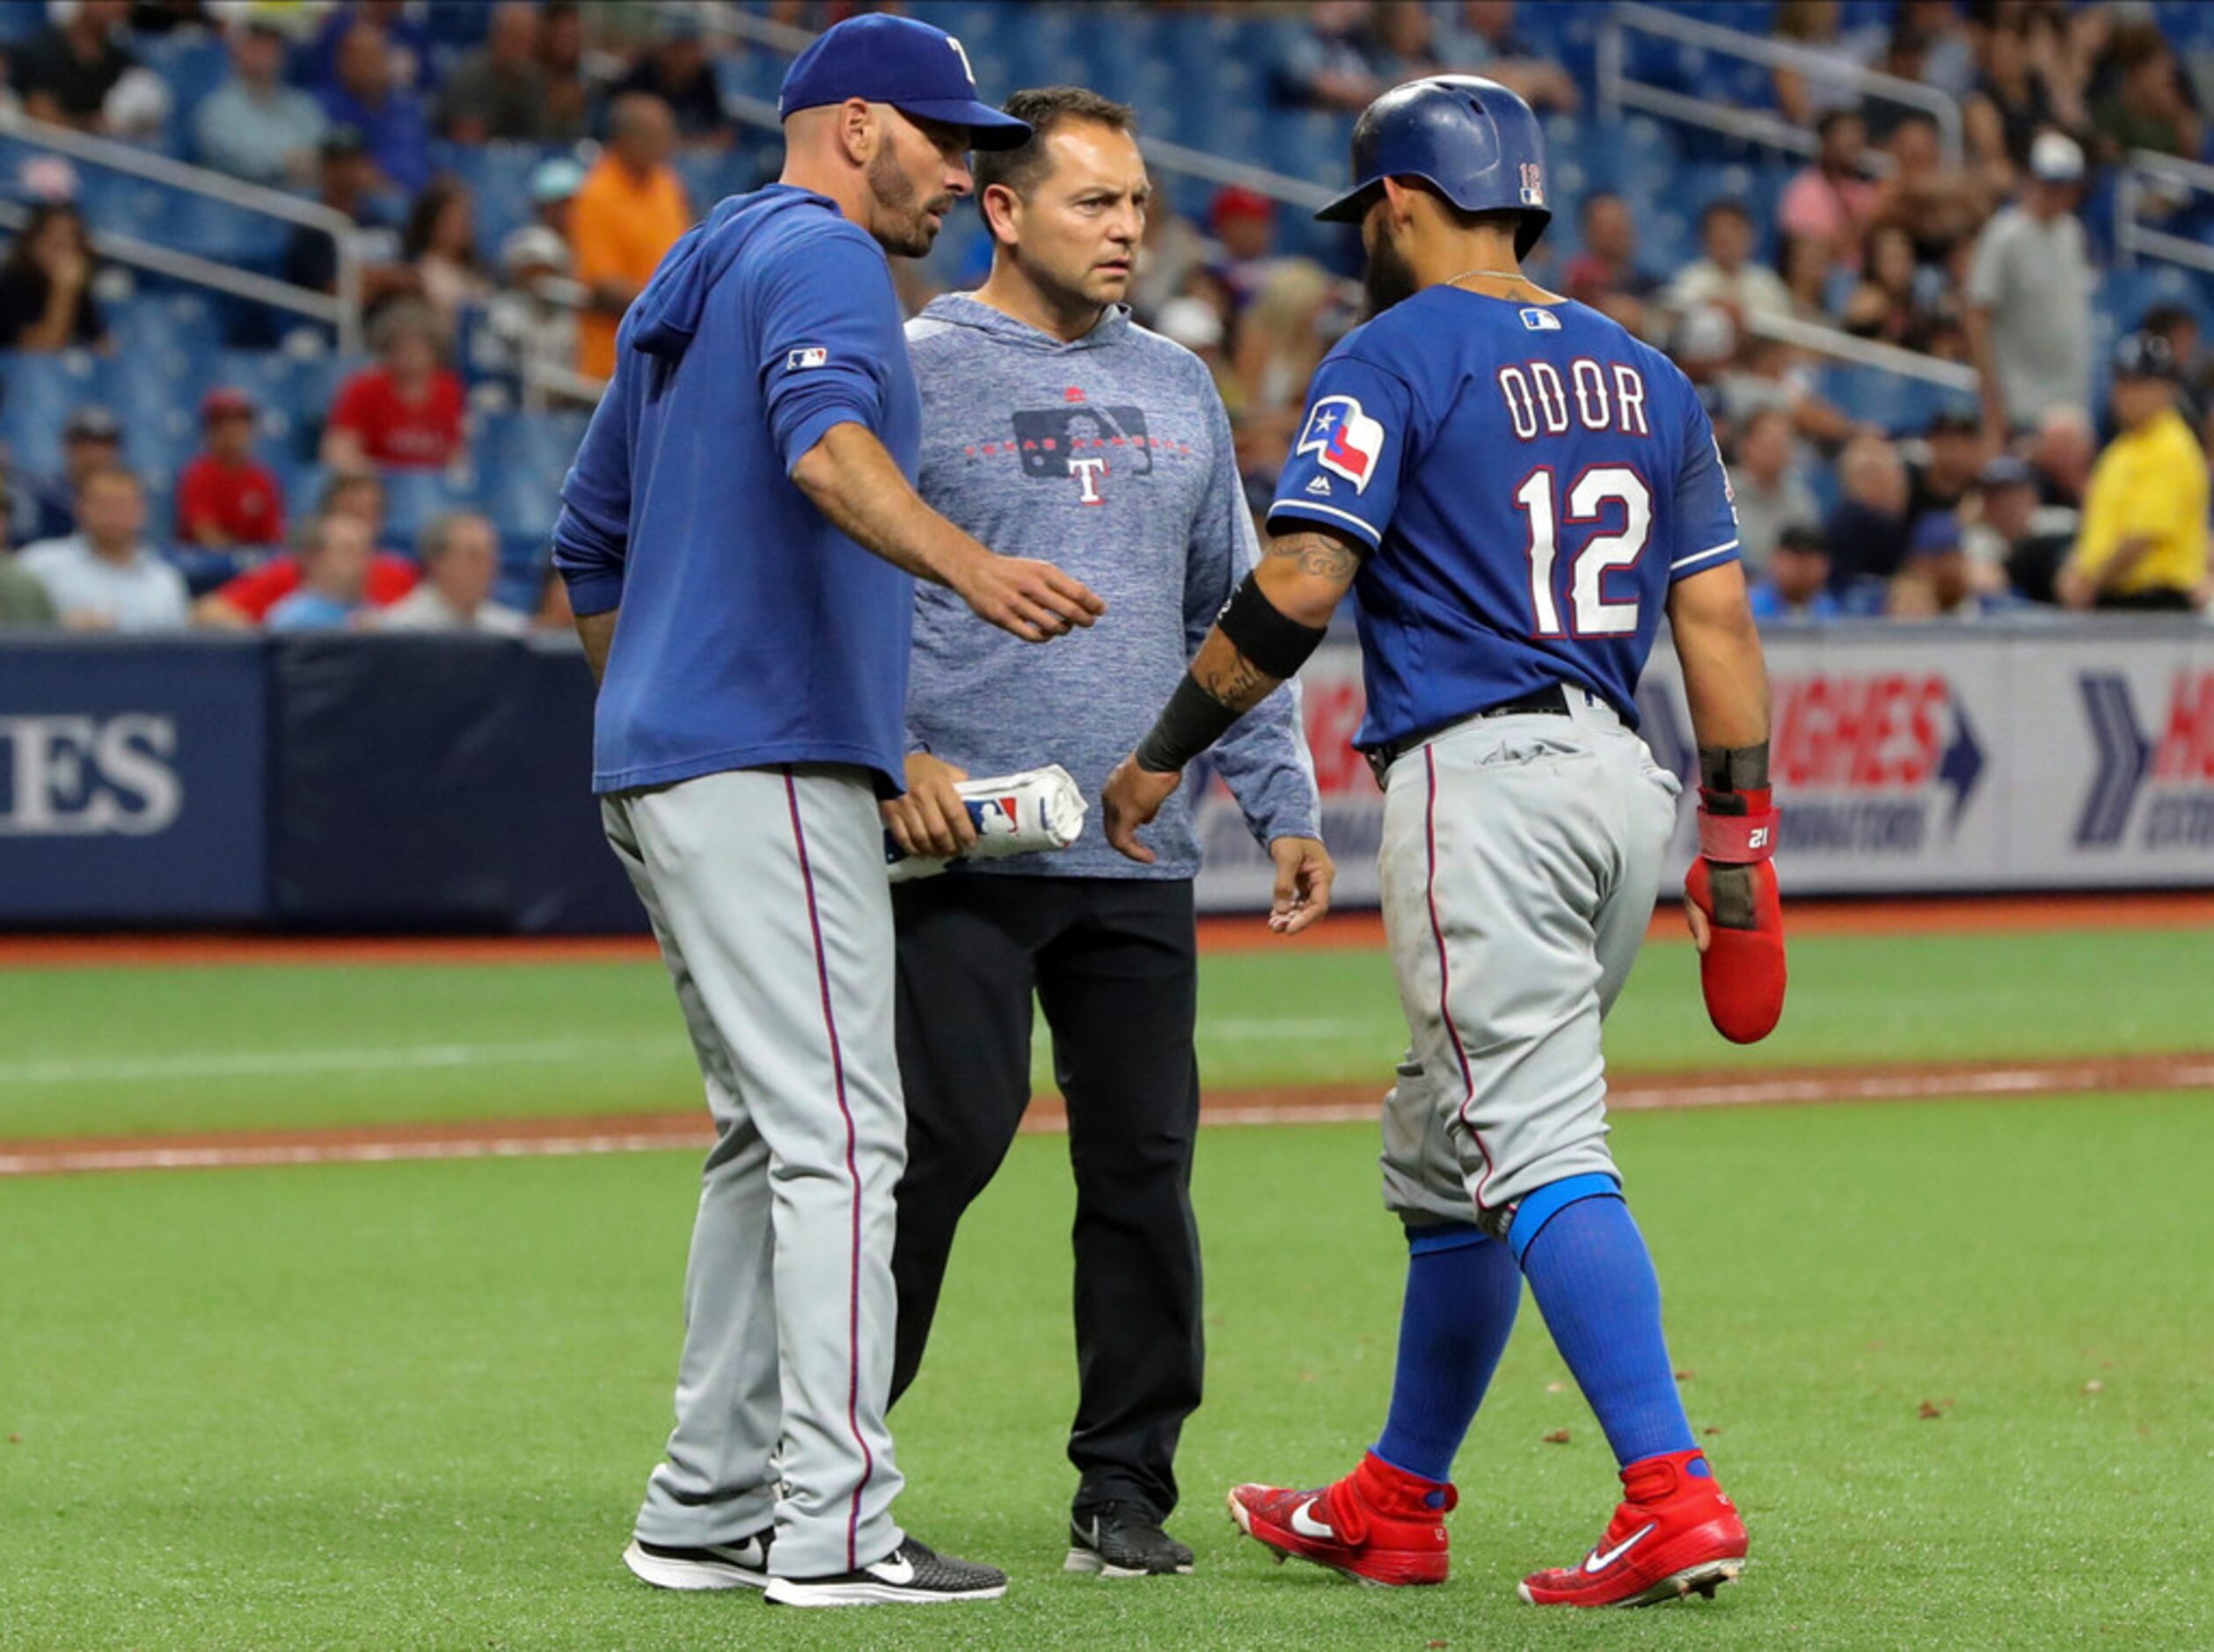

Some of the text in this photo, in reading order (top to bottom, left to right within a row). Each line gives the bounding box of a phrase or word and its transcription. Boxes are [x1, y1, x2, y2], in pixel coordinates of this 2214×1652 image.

[1497, 357, 1650, 441] ODOR
[1067, 457, 1111, 506] T
[1512, 463, 1652, 640] 12
